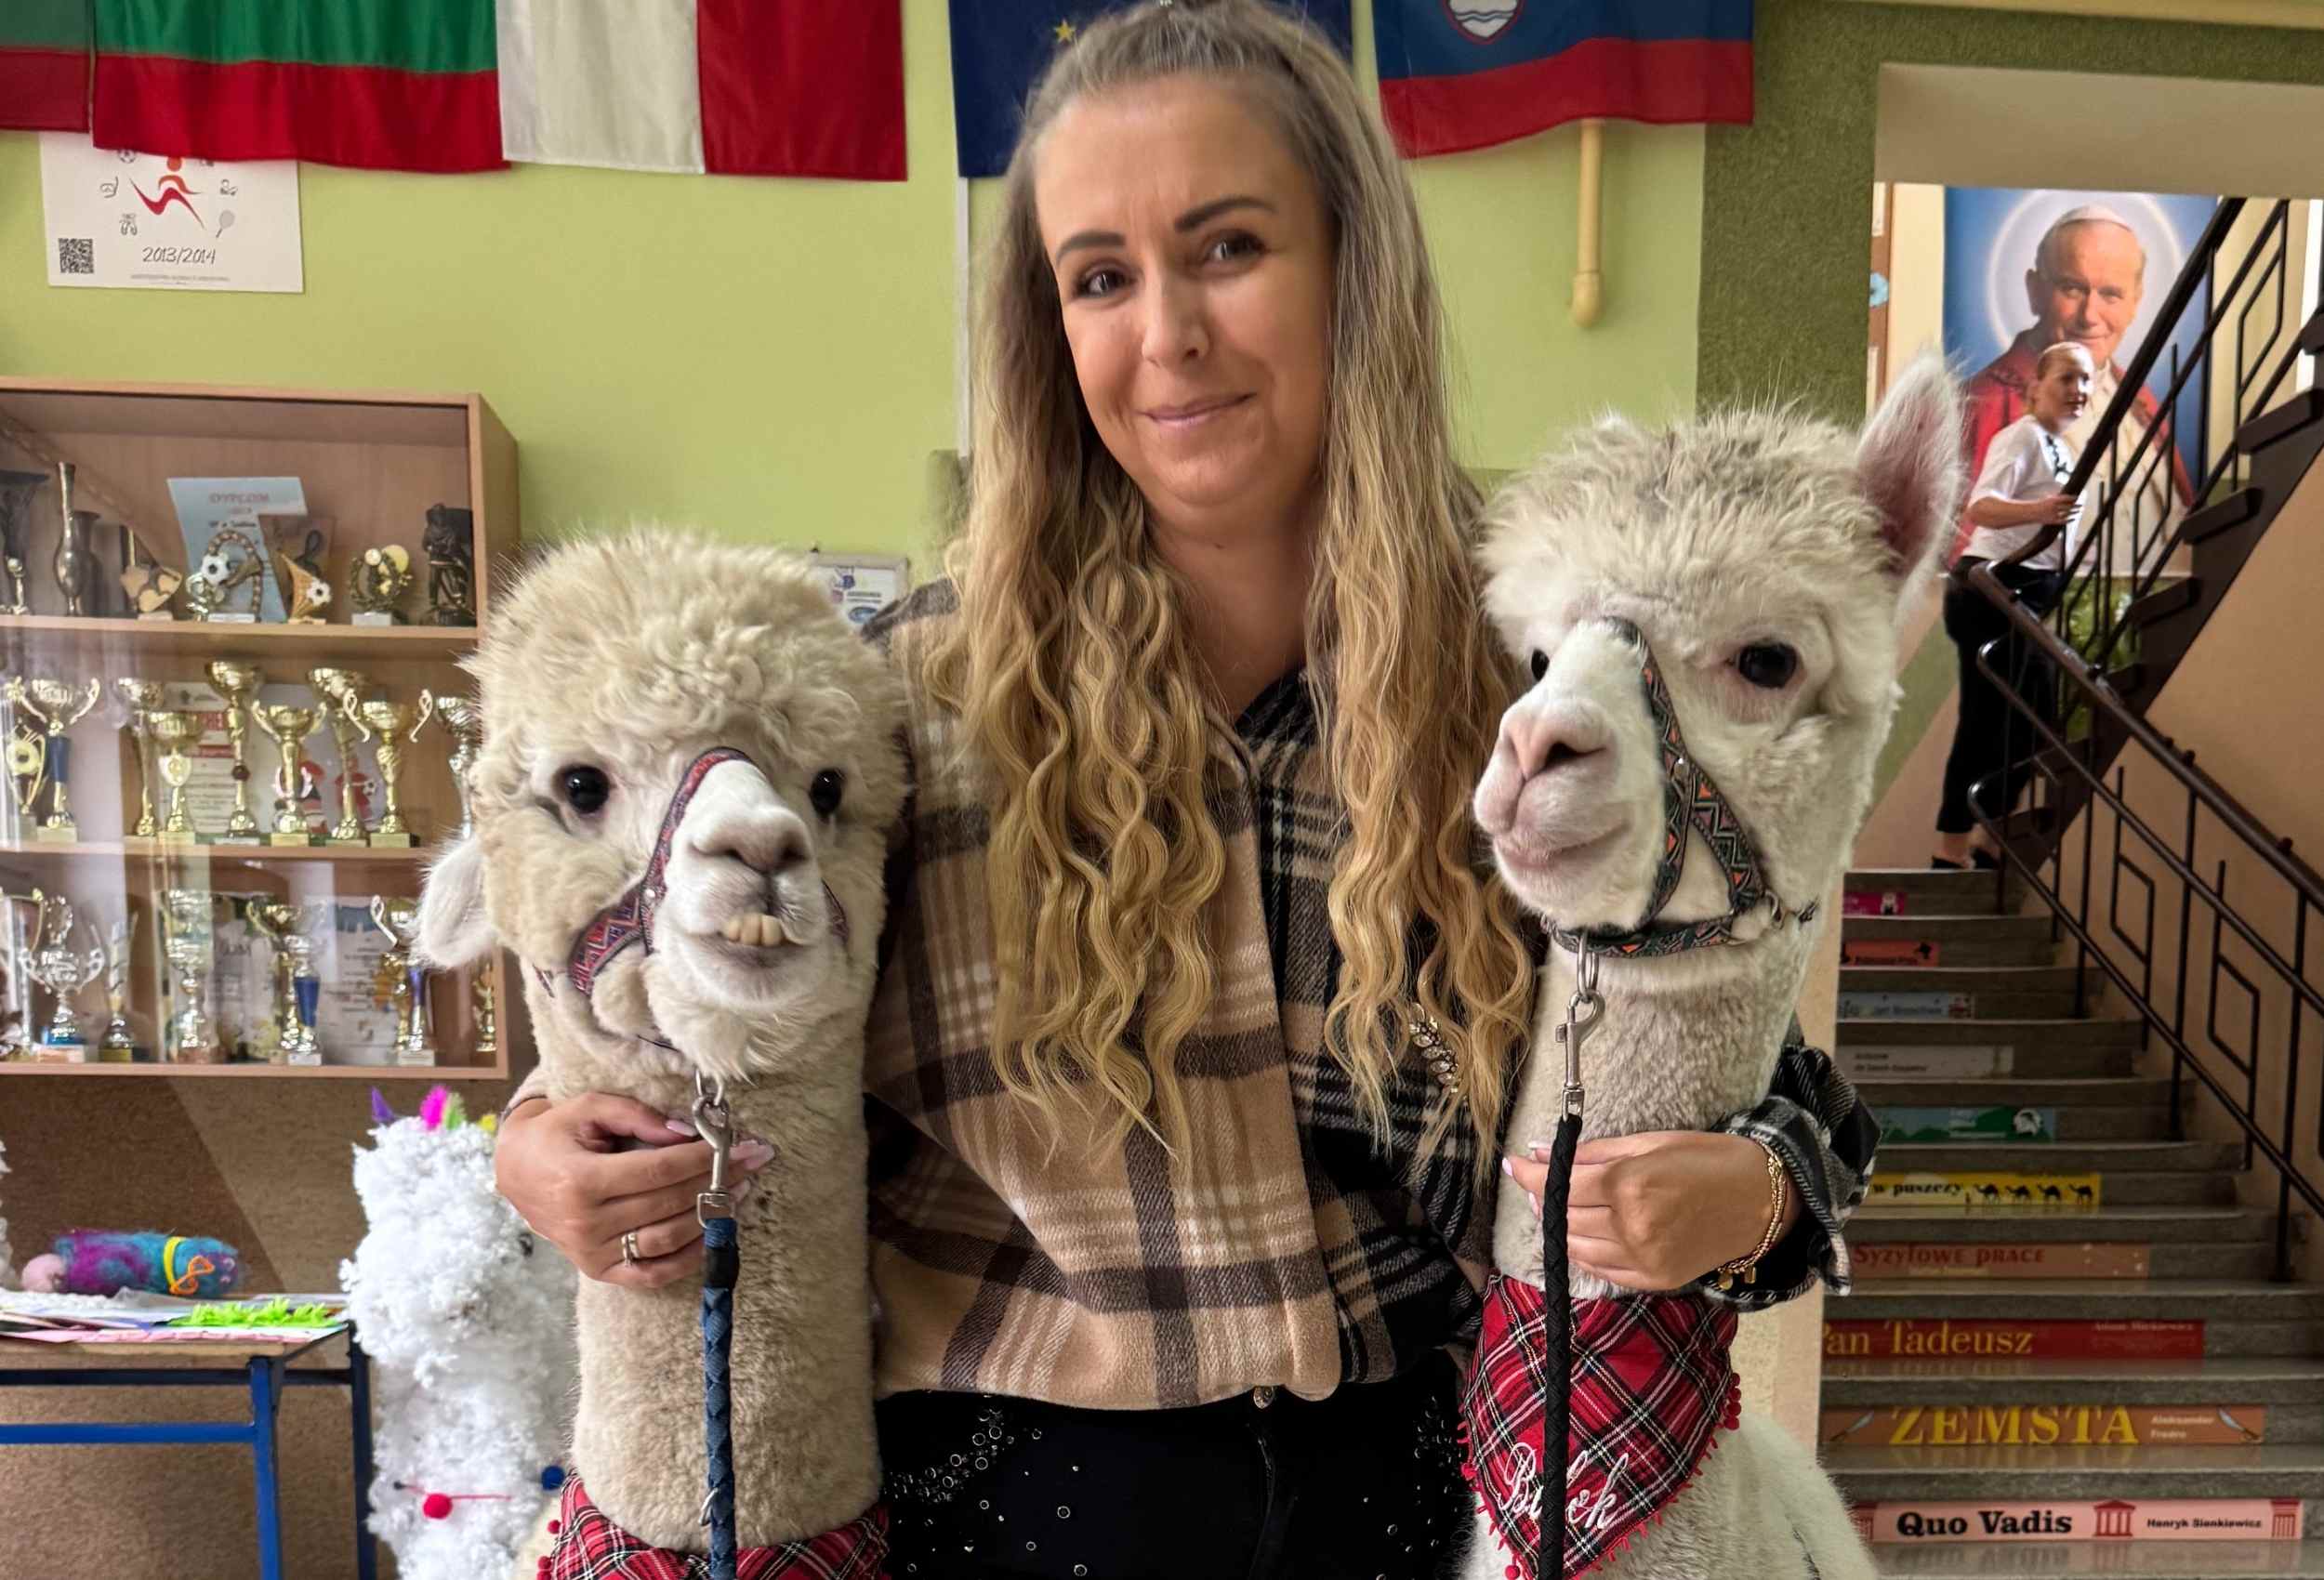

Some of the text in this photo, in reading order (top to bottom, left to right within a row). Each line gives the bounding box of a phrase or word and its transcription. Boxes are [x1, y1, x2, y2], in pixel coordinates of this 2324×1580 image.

[142, 246, 217, 265] 2013/2014
[1893, 1182, 1961, 1197] puszczy
[1883, 1319, 2034, 1355] Tadeusz
[1888, 1404, 2140, 1446] ZEMSTA
[1896, 1509, 2073, 1537] Quo Vadis
[2146, 1518, 2188, 1530] Henryk
